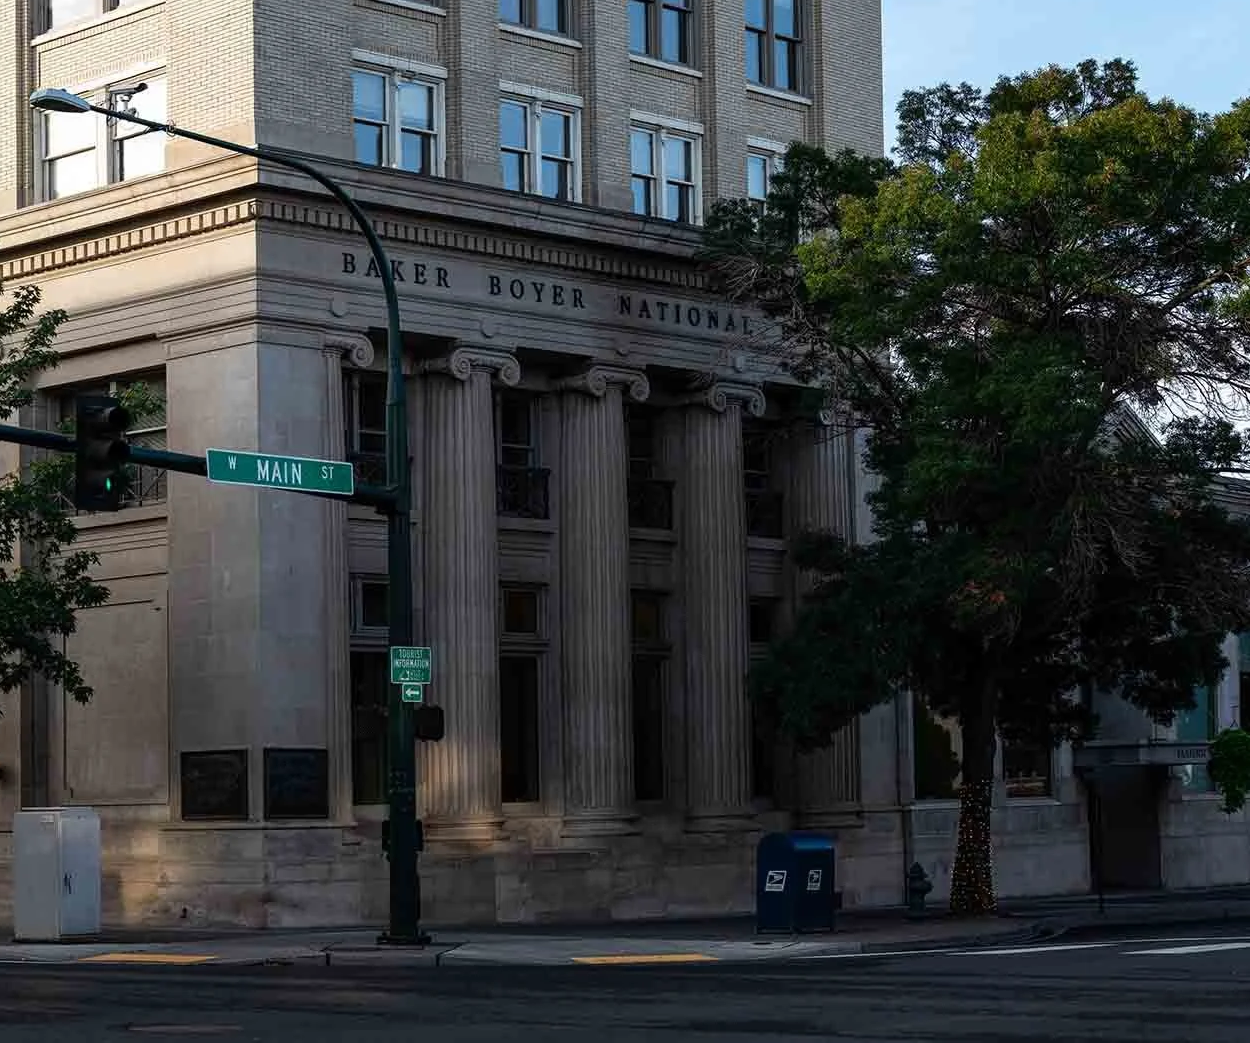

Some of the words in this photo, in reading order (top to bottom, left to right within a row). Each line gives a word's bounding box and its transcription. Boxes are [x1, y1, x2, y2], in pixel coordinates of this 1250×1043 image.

[341, 252, 451, 288] BAKER
[488, 274, 587, 309] BOYER
[618, 295, 754, 335] NATIONAL
[227, 454, 237, 470] W
[257, 459, 302, 485] MAIN
[321, 465, 334, 480] ST
